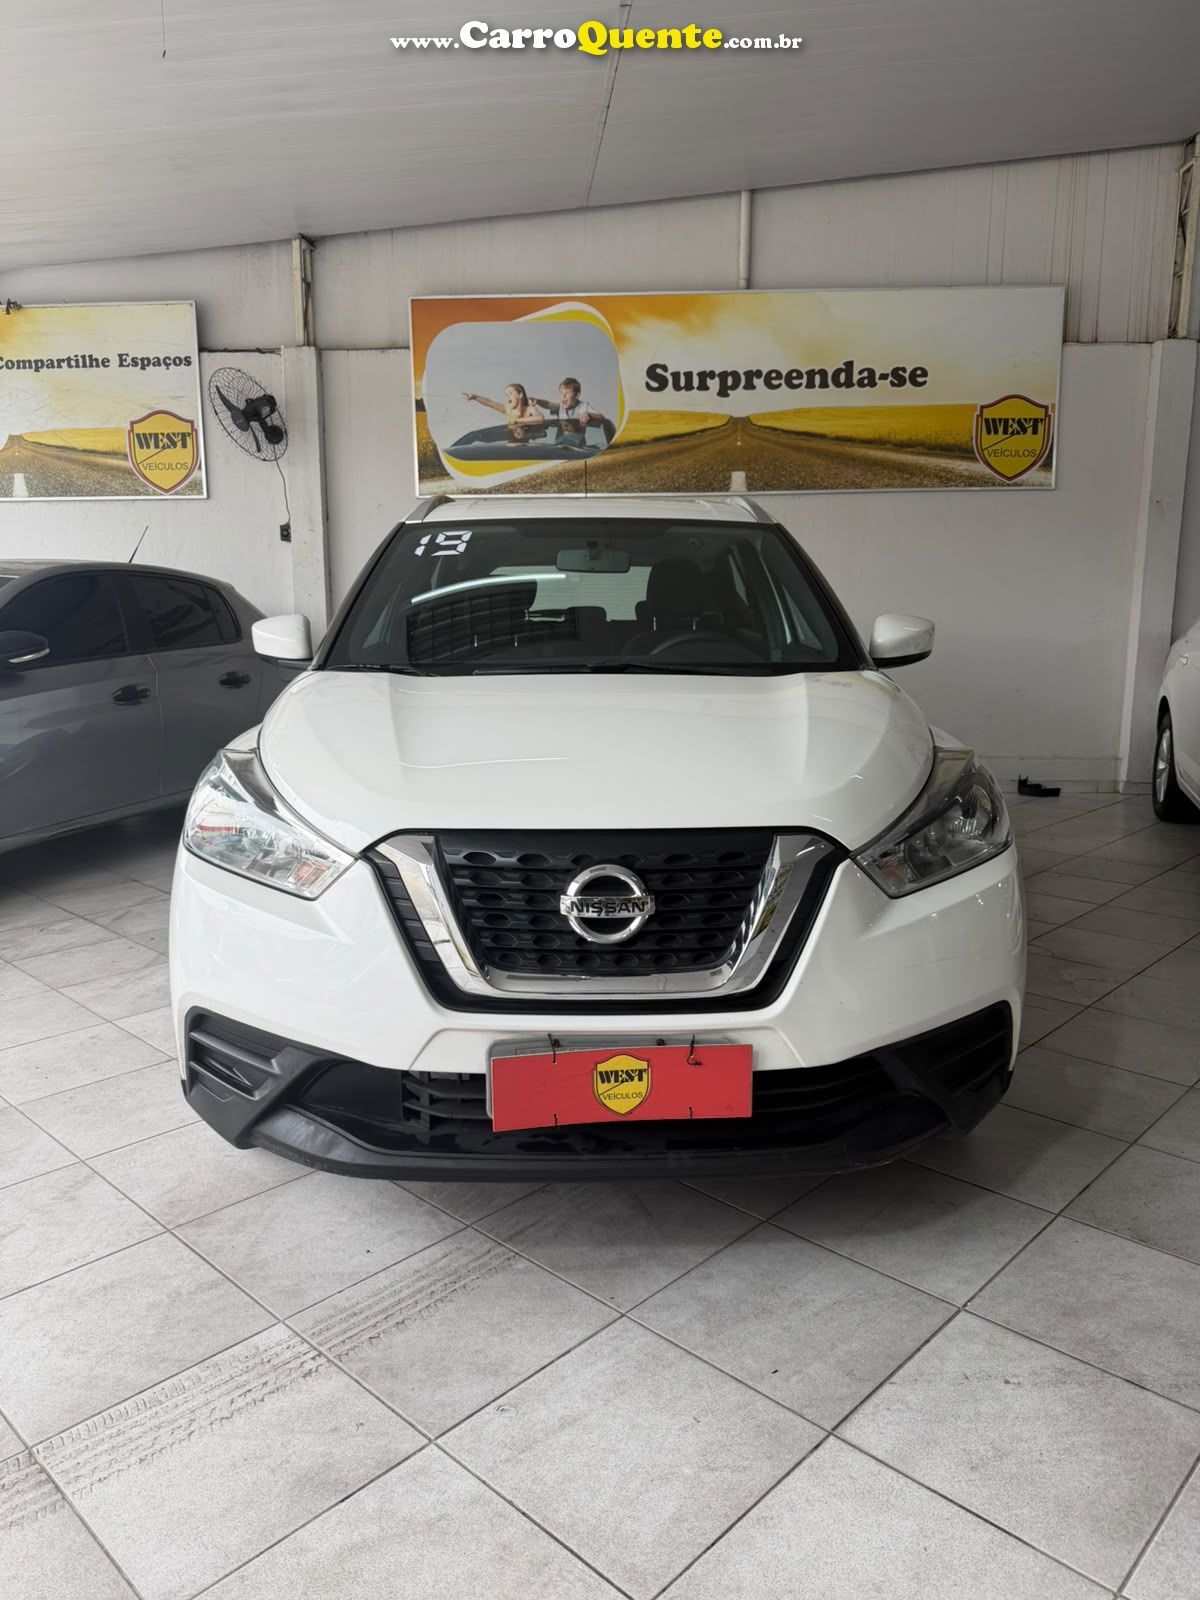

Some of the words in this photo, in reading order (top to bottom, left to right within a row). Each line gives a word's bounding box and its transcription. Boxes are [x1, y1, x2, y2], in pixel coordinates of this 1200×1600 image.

[117, 352, 193, 371] Espaços
[645, 360, 929, 397] Surpreenda-se
[984, 417, 1044, 436] WEST
[135, 431, 192, 450] WEST
[987, 448, 1037, 458] VEÍCULOS
[142, 461, 189, 472] VEÍCULOS
[414, 530, 473, 557] 19
[570, 901, 648, 914] NISSAN
[598, 1067, 648, 1084] WEST
[603, 1090, 644, 1101] VEÍCULOS
